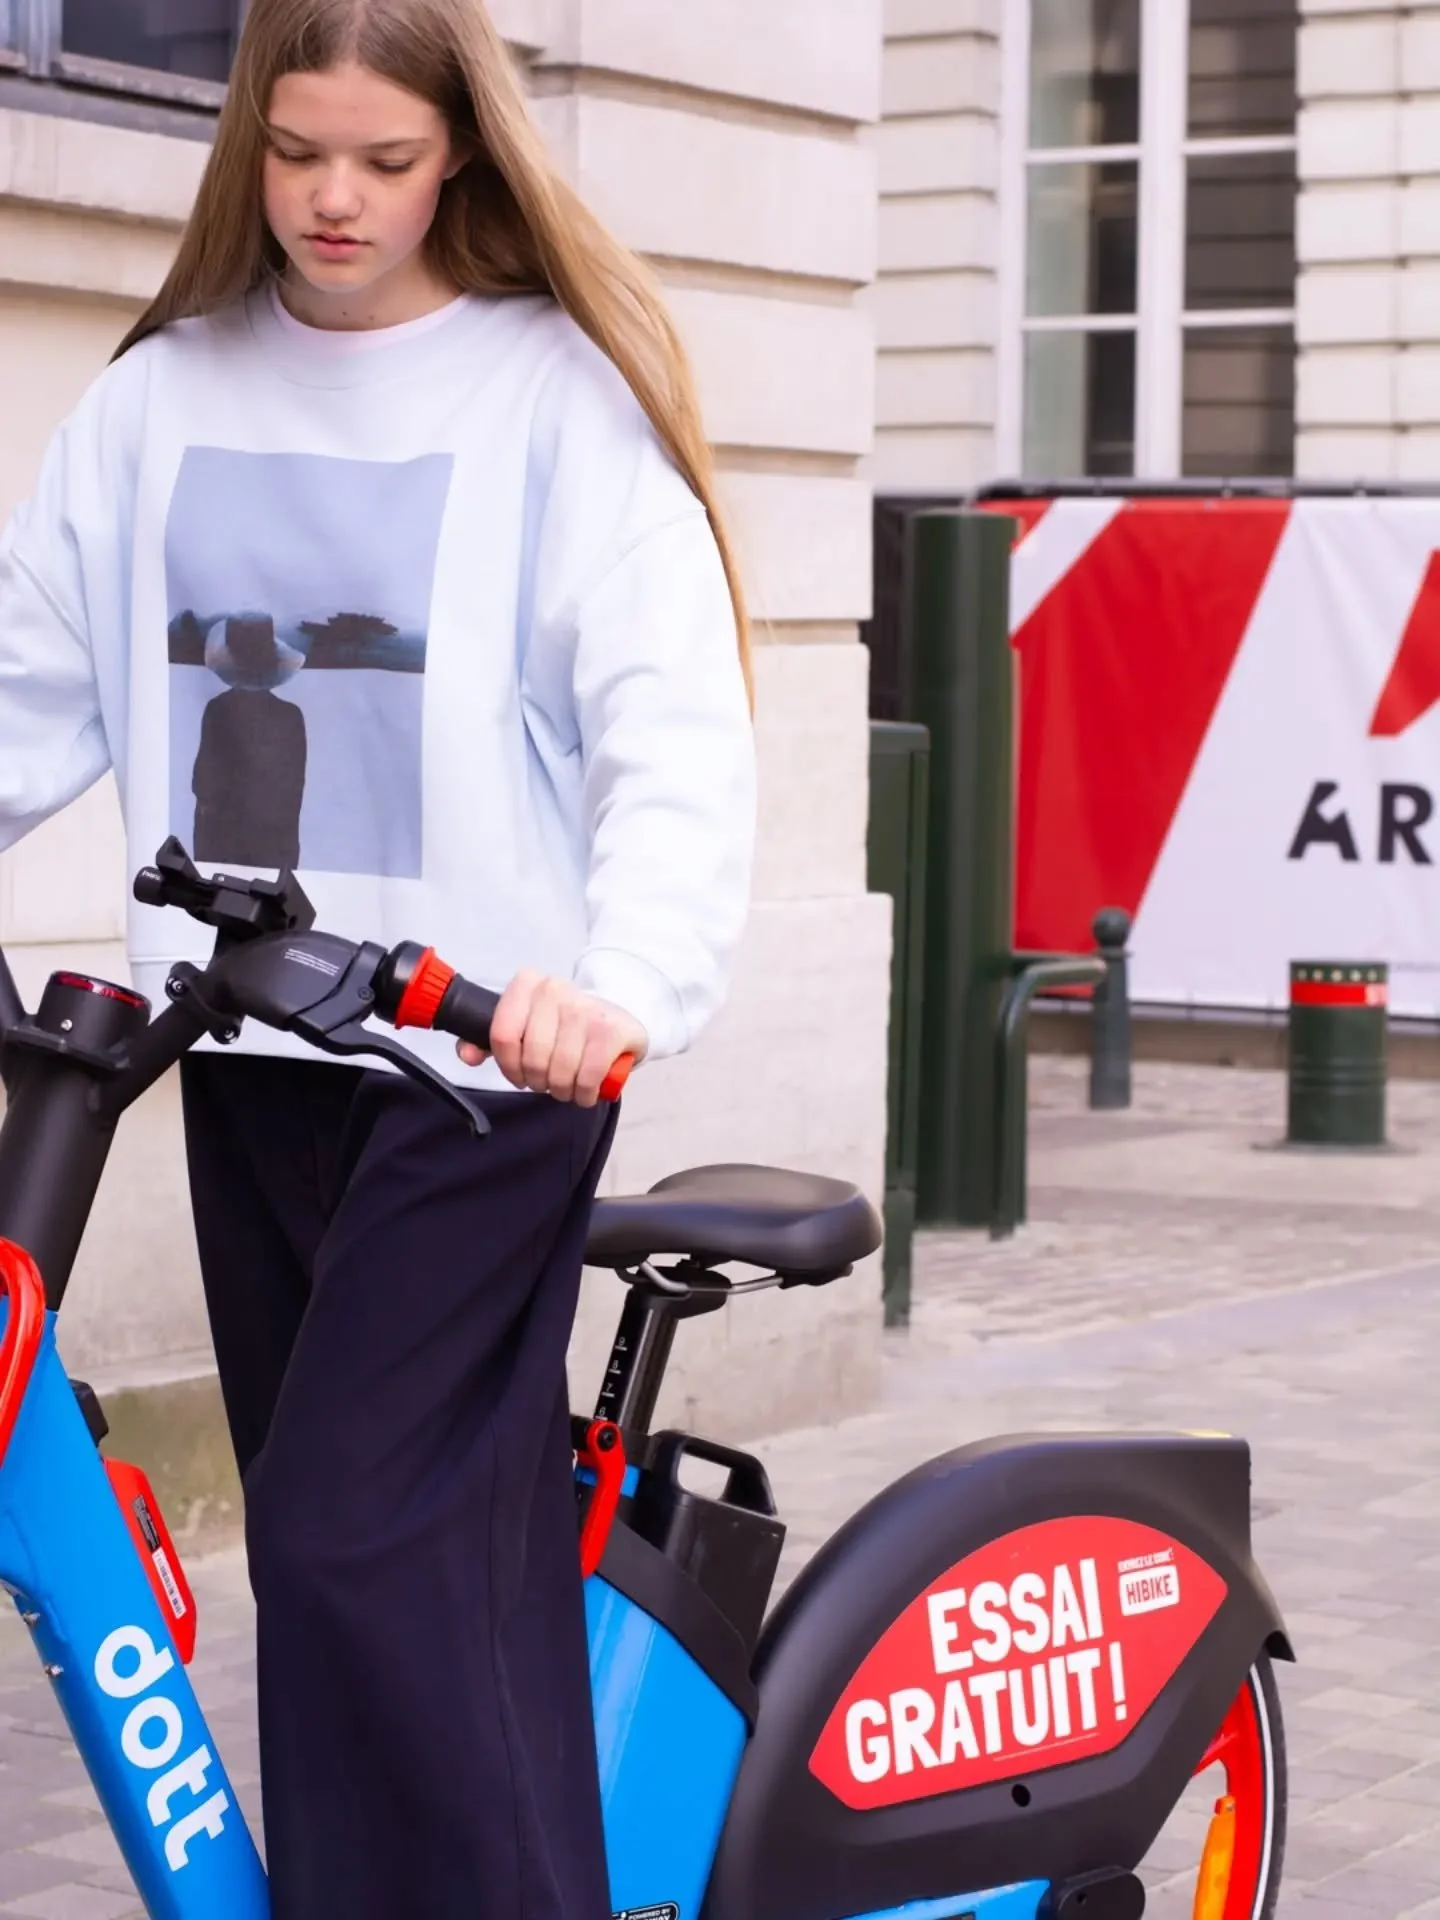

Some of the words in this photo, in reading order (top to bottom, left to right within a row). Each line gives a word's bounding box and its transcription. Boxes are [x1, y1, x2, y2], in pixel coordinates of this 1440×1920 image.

[927, 1558, 1104, 1674] ESSAI
[1126, 1573, 1173, 1606] HIBIKE
[94, 1625, 230, 1872] dott
